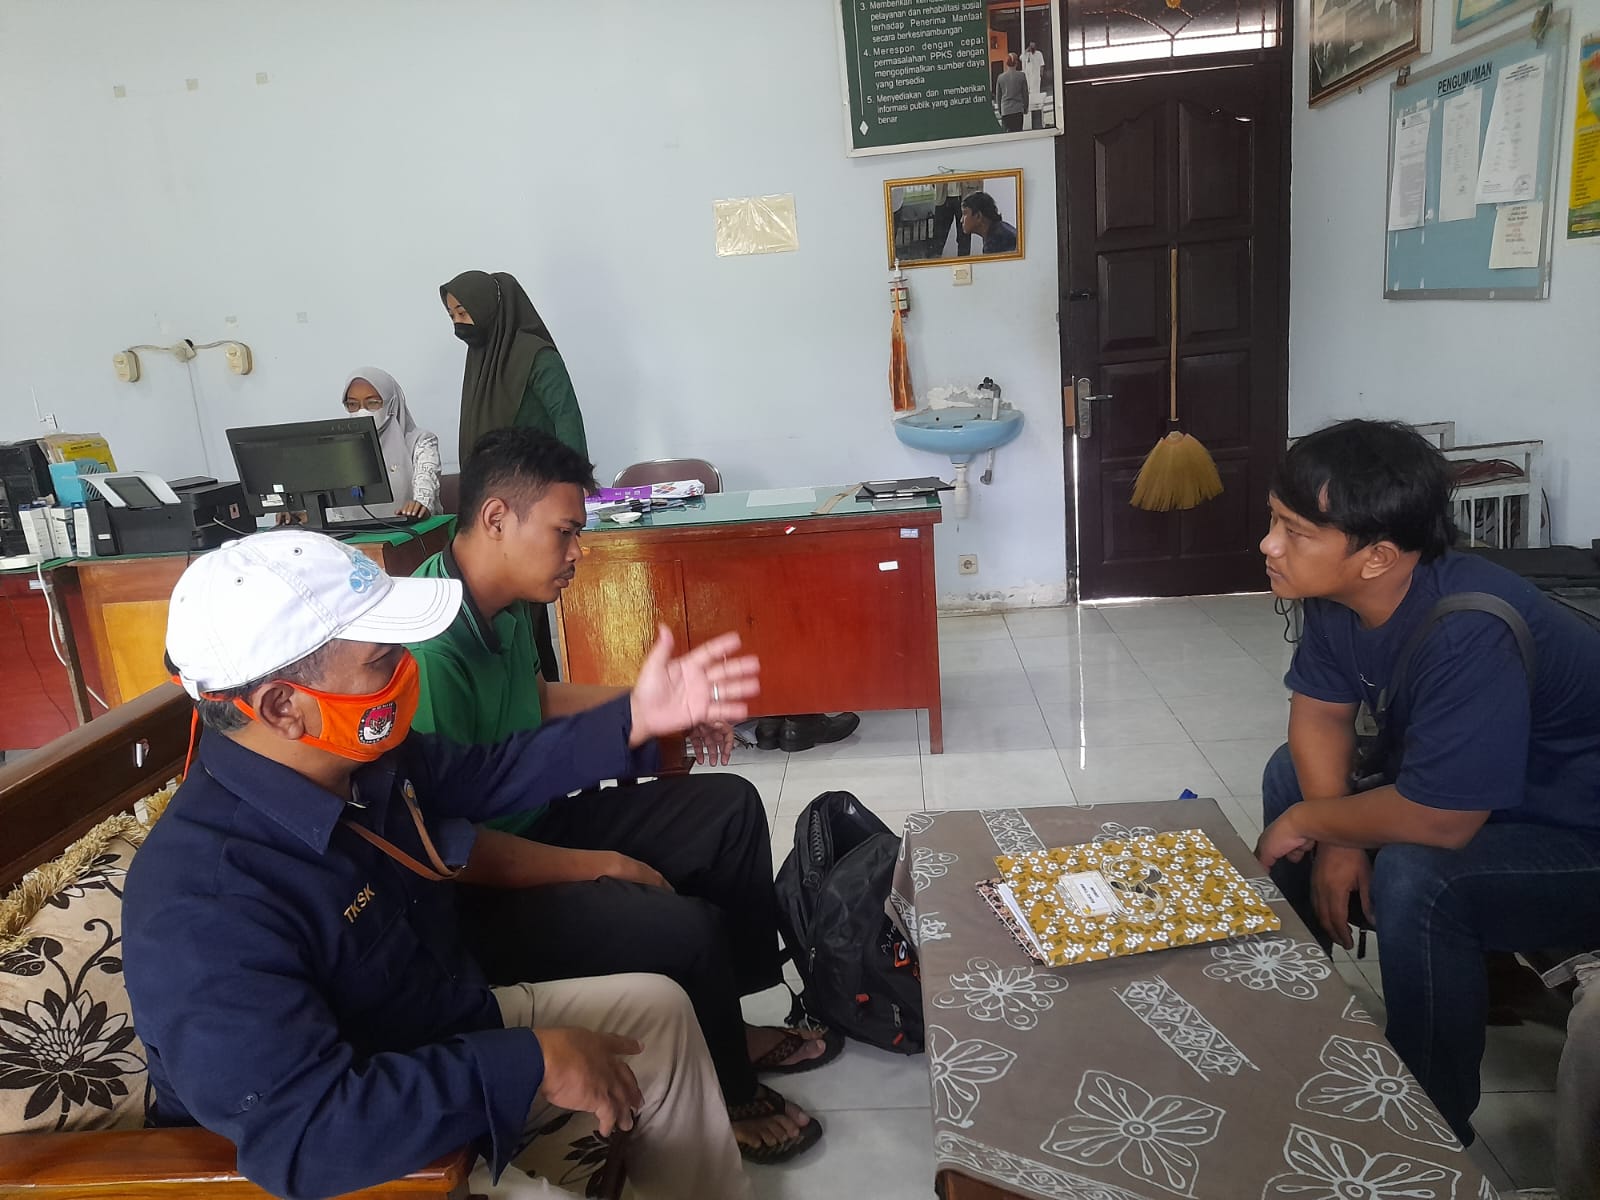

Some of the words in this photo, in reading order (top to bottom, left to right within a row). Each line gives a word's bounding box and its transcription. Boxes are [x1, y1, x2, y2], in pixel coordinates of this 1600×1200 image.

[870, 8, 907, 21] pelayanan
[908, 8, 921, 16] dan
[922, 4, 960, 16] rehabilitasi
[961, 0, 982, 10] sosial
[871, 21, 905, 32] terhadap
[910, 17, 946, 28] Penerima
[952, 12, 983, 22] Manfaat
[872, 34, 896, 42] secara
[897, 26, 963, 40] berkesinambungan
[863, 49, 872, 57] 4.
[873, 45, 915, 57] Merespon
[921, 40, 954, 51] dengan
[960, 37, 985, 48] cepat
[873, 54, 927, 68] permasalahan
[930, 51, 953, 60] PPKS
[956, 48, 985, 60] dengan
[874, 64, 936, 78] mengoptimalkan
[937, 60, 965, 71] sumber
[966, 58, 985, 69] daya
[875, 80, 894, 90] yang
[895, 76, 925, 86] tersedia
[1437, 62, 1493, 94] PENGUMUMAN
[876, 91, 922, 103] Menyediakan
[926, 89, 939, 97] dan
[943, 84, 986, 96] memberikan
[877, 103, 908, 114] informasi
[909, 100, 930, 111] publik
[931, 99, 949, 109] yang
[949, 96, 971, 106] akurat
[973, 95, 986, 104] dan
[878, 115, 898, 125] benar
[343, 882, 376, 923] TKSK
